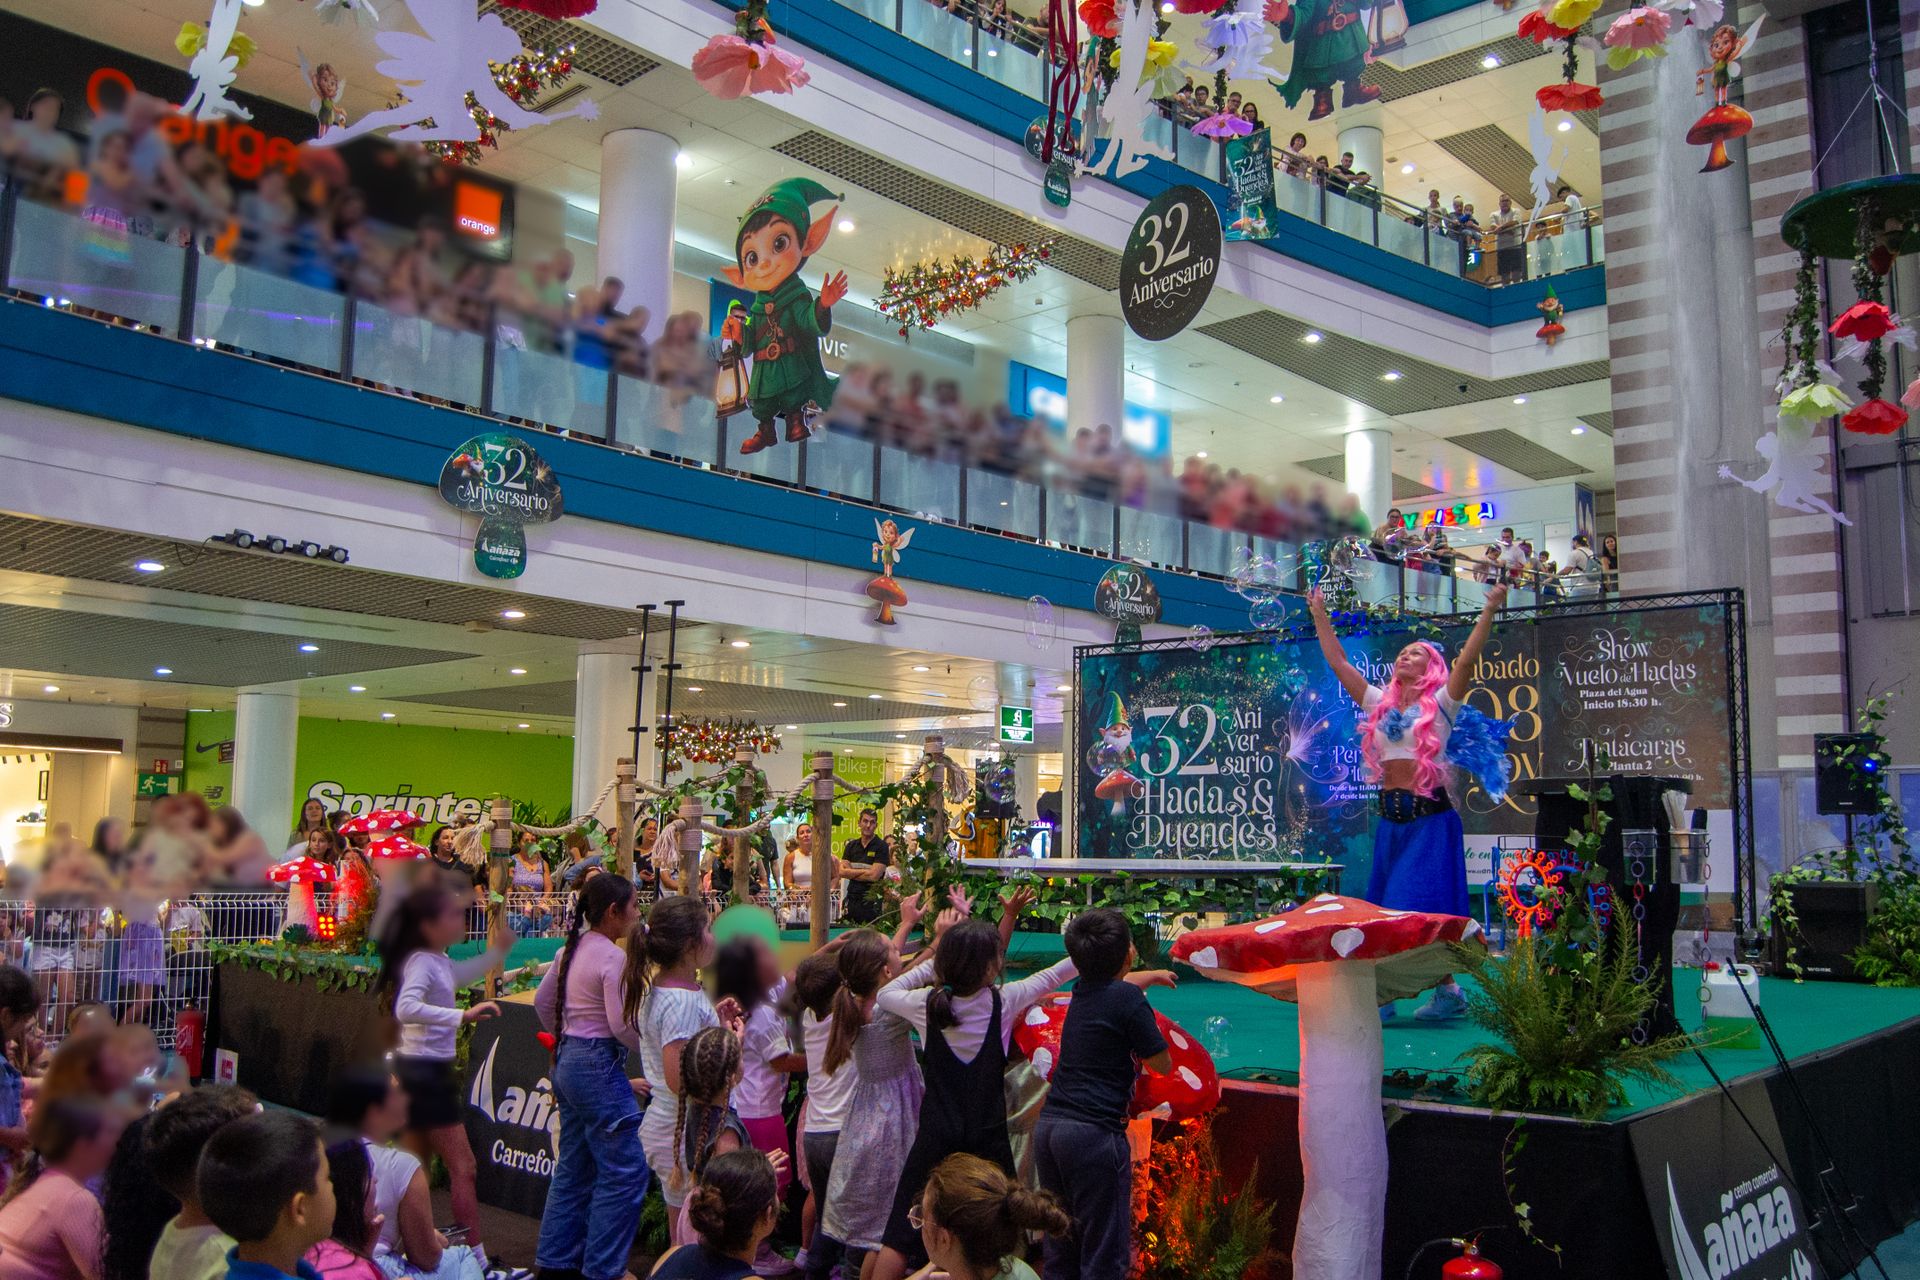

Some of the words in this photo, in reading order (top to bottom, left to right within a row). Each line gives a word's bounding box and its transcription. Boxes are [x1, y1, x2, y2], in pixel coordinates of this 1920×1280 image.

[461, 217, 496, 235] orange
[1139, 202, 1190, 276] 32
[1129, 256, 1214, 307] Aniversario
[484, 443, 527, 490] 32
[457, 480, 548, 516] Aniversario
[1118, 570, 1142, 602] 32
[1104, 597, 1154, 620] Aniversario
[1597, 628, 1653, 662] Show
[1558, 658, 1618, 686] Vuelo
[1620, 673, 1632, 683] de
[1627, 659, 1697, 694] Hadas
[1579, 688, 1606, 698] Plaza
[1607, 688, 1622, 697] del
[1624, 687, 1648, 698] Agua
[1584, 699, 1615, 710] Inicio
[1617, 697, 1648, 708] 18:30
[1651, 697, 1662, 707] h.
[1221, 707, 1263, 735] Ani
[1140, 703, 1219, 776] 32
[1226, 732, 1260, 752] ver
[839, 757, 867, 773] Bike
[1221, 753, 1274, 785] sario
[1645, 760, 1652, 770] 2
[1125, 814, 1279, 860] Duendes
[1734, 1180, 1752, 1199] centro
[1752, 1163, 1778, 1189] comercial
[1704, 1186, 1796, 1280] añaza
